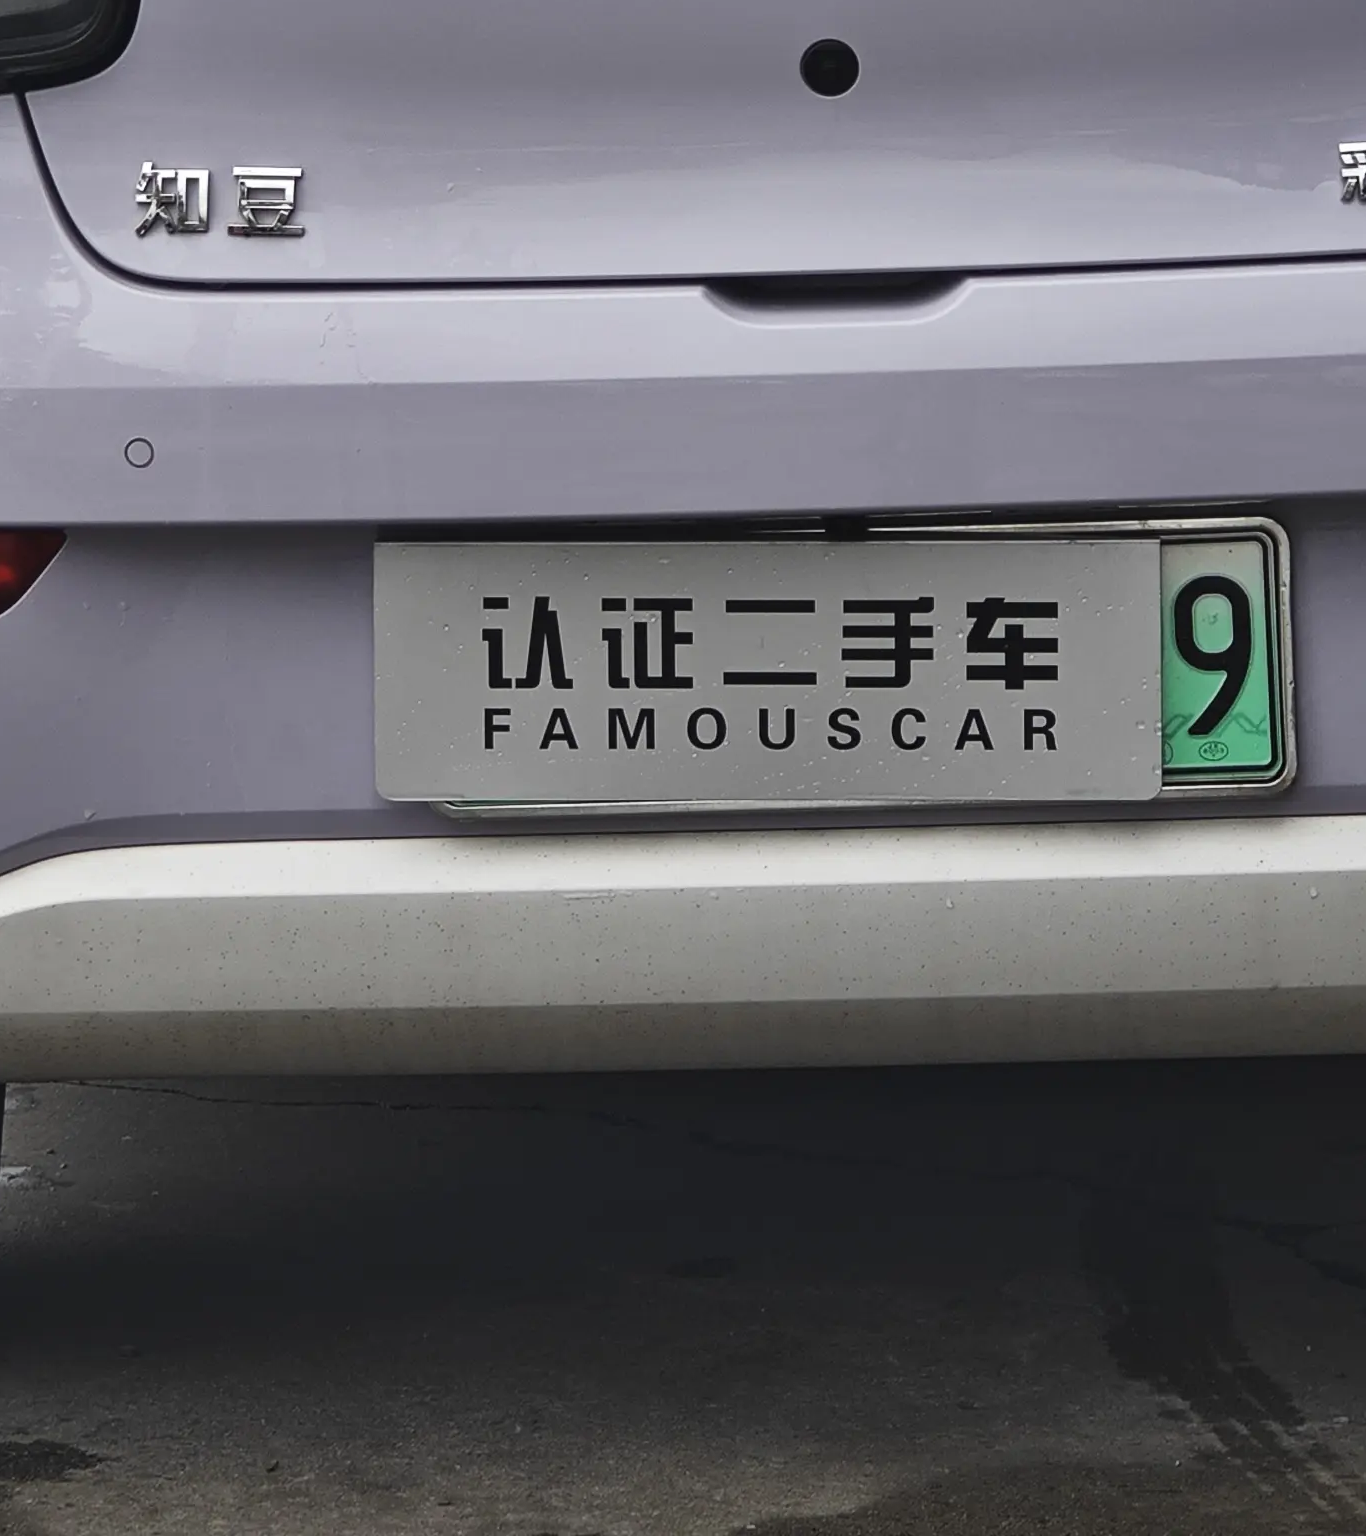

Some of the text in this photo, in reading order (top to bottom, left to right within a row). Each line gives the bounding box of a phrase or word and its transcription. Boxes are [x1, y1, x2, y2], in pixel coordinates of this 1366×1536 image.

[135, 161, 305, 237] 知豆
[482, 596, 1059, 690] 认证二手车
[1174, 575, 1252, 735] 9
[484, 707, 1058, 750] FAMOUSCAR
